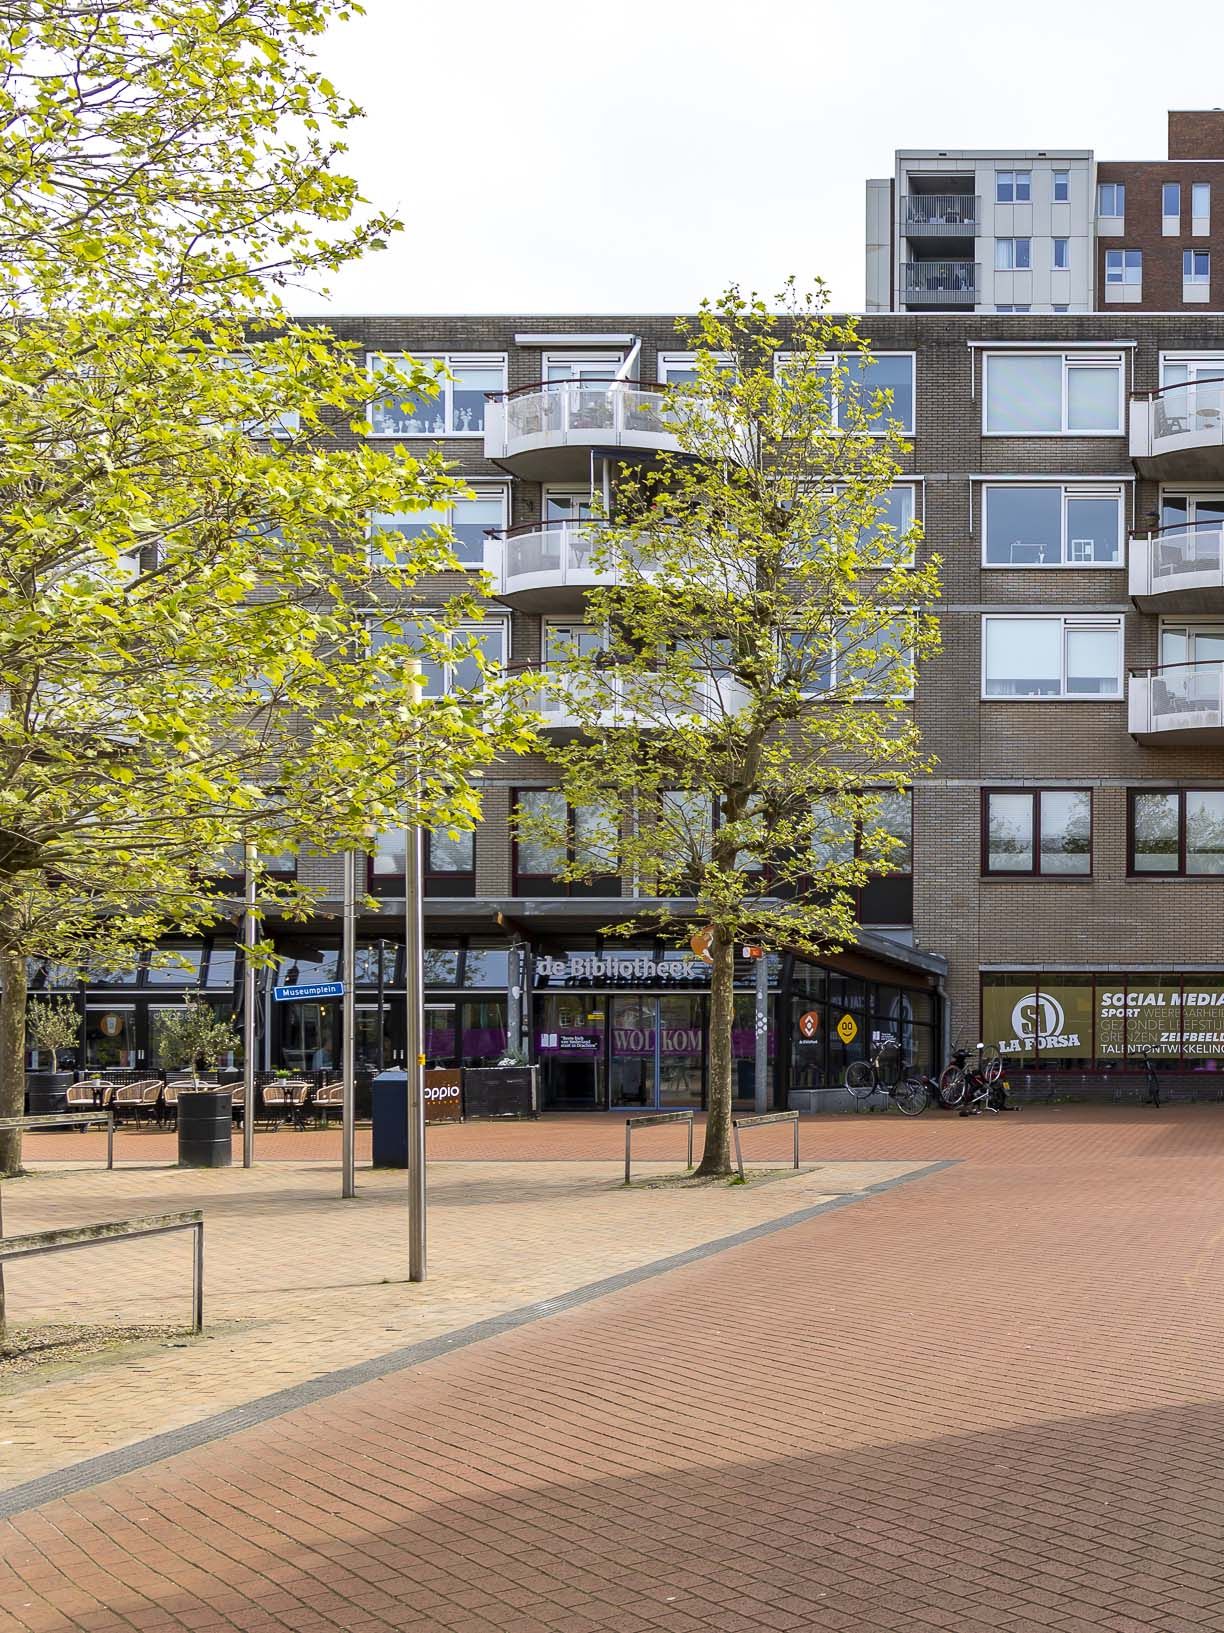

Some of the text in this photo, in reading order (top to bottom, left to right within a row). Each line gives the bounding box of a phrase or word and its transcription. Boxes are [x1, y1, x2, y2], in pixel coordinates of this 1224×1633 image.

[537, 956, 697, 978] de Bibliotheek
[282, 985, 337, 997] Museumplein
[1101, 993, 1166, 1006] SOCIAL
[1101, 1008, 1141, 1018] SPORT
[999, 1034, 1081, 1053] LA FORSA
[424, 1083, 460, 1101] oppio
